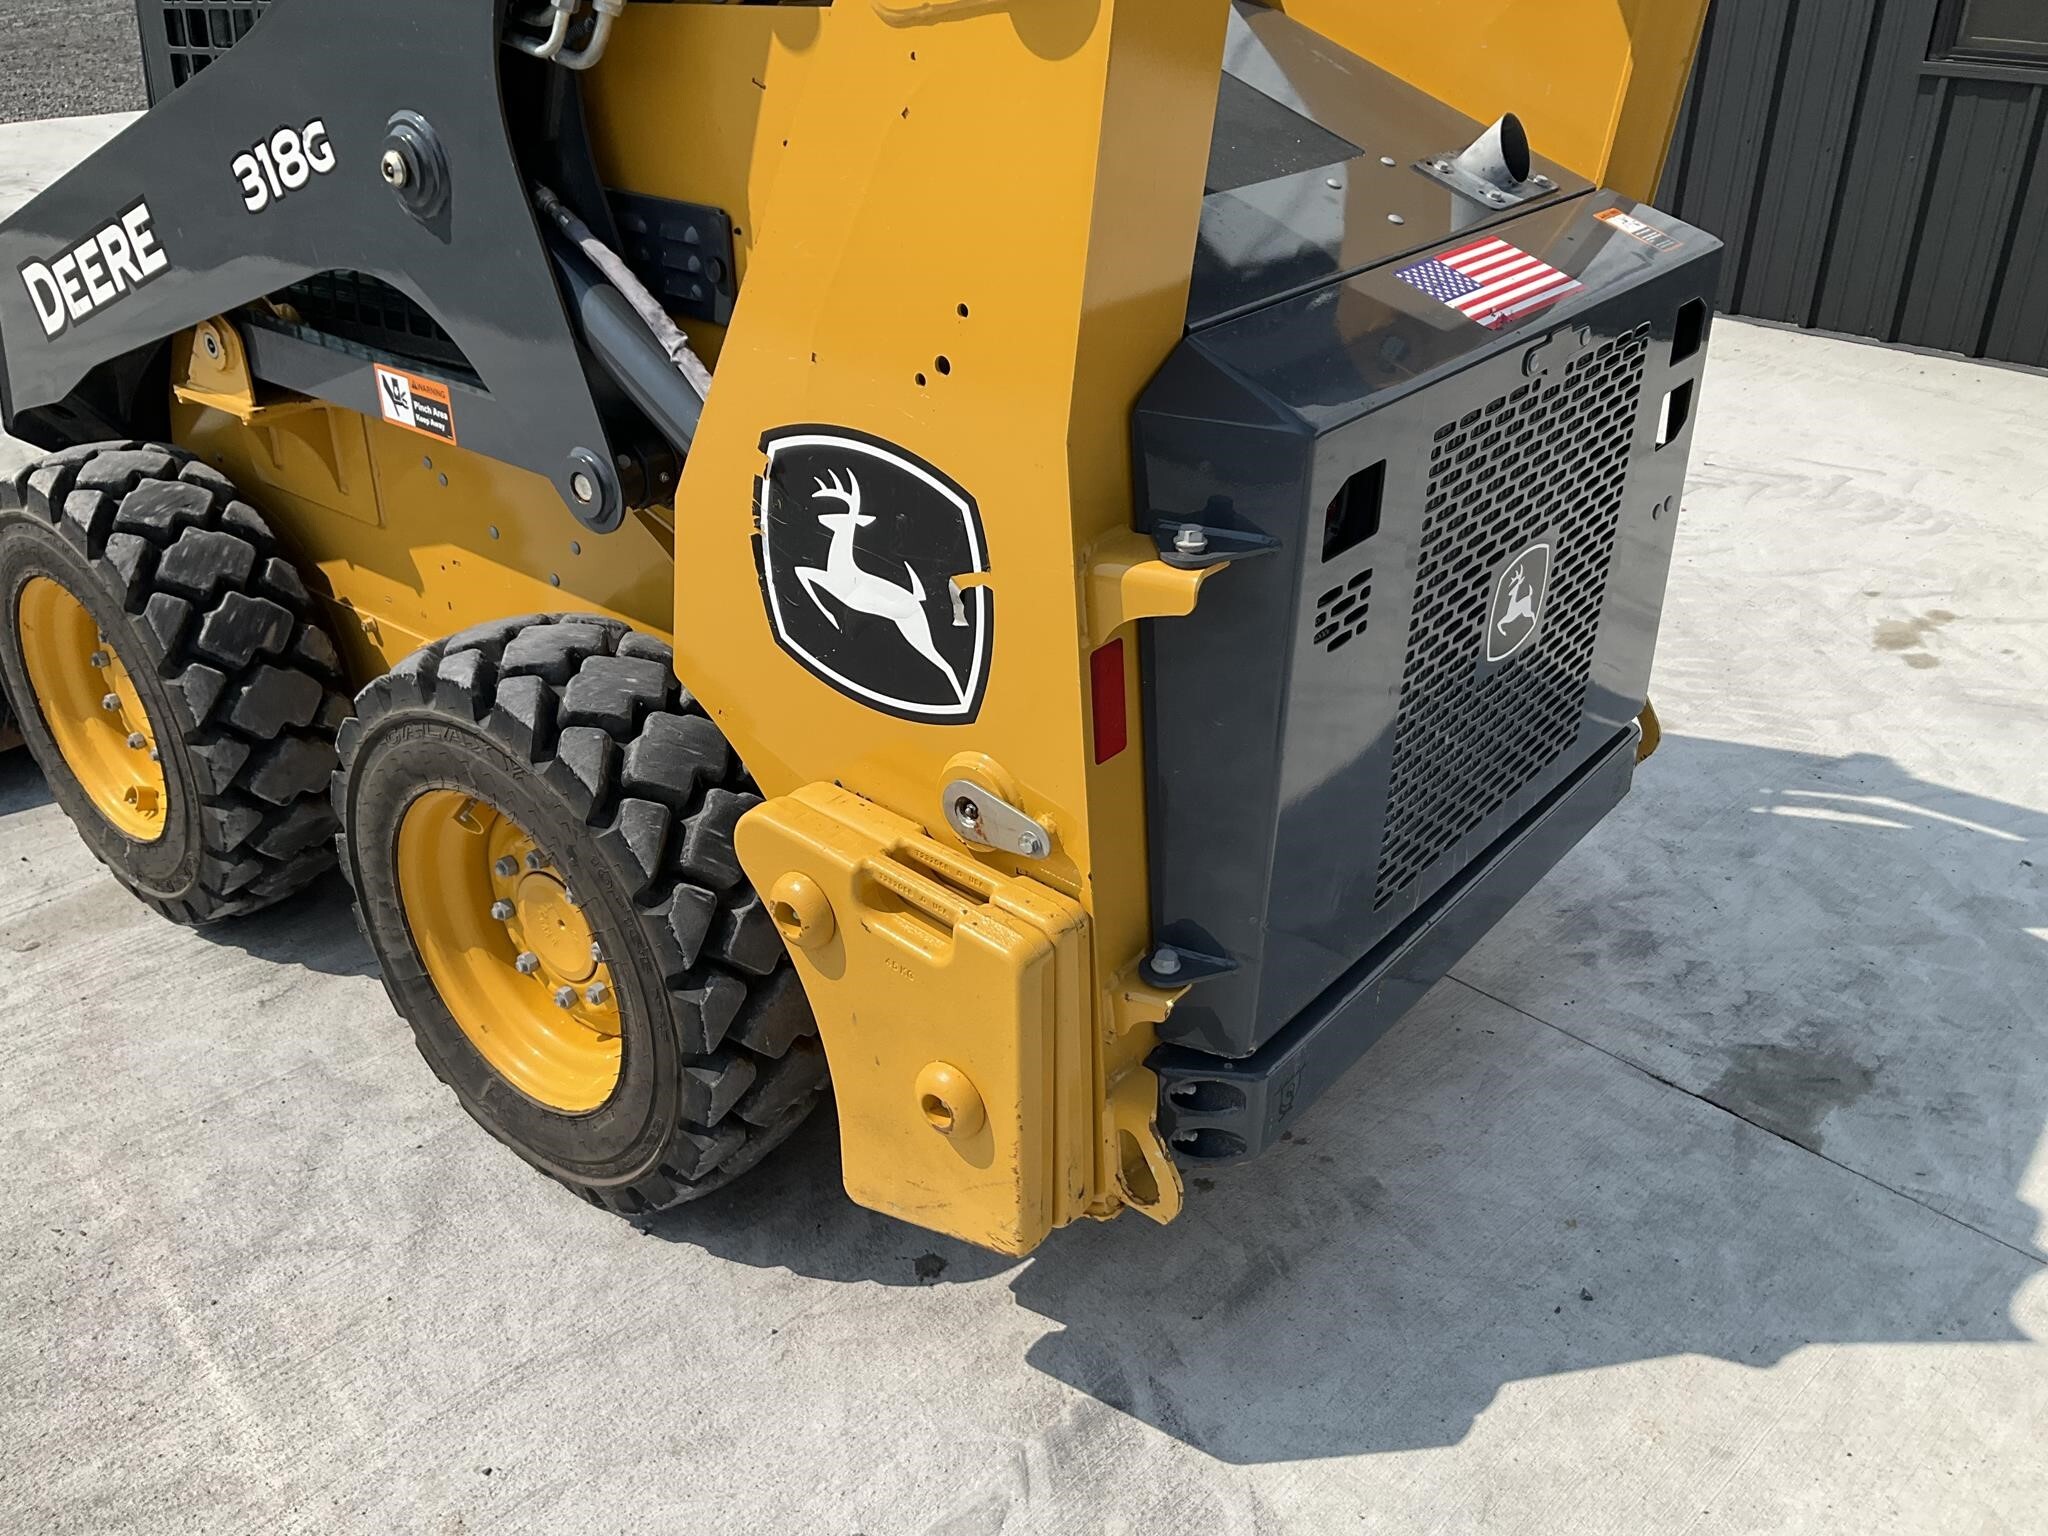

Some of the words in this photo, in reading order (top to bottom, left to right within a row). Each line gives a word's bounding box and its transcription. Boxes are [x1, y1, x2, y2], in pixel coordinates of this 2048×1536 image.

[231, 119, 336, 212] 318G
[20, 201, 168, 337] DEERE
[413, 400, 433, 415] Pinch
[433, 407, 449, 421] Area
